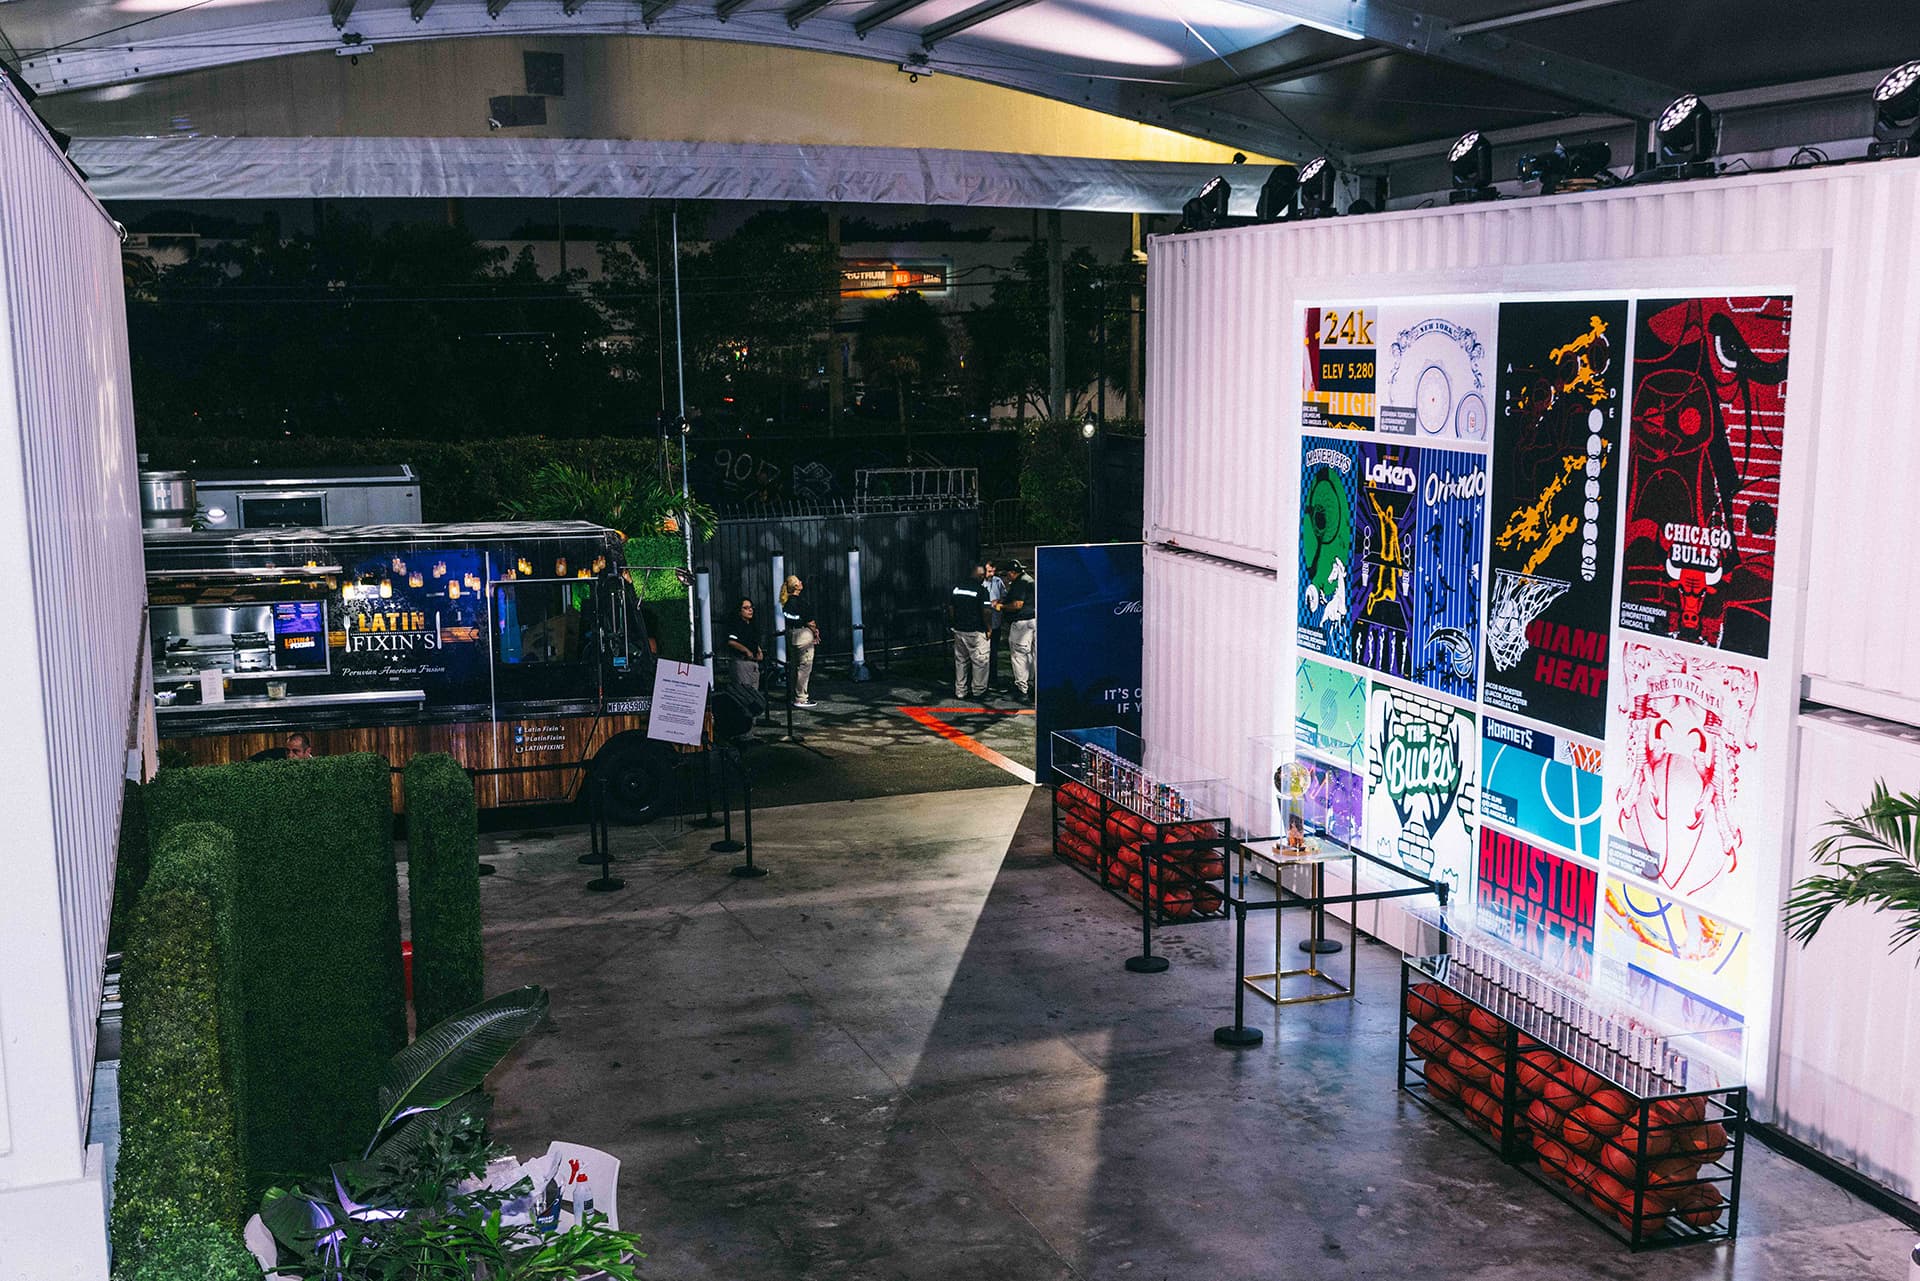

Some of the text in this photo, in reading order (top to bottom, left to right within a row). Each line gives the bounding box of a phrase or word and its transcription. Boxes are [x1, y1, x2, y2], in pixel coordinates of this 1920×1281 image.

[1323, 309, 1374, 345] 24k
[1322, 361, 1374, 381] ELEV 5,280
[1506, 363, 1513, 374] A
[1609, 388, 1616, 398] D
[1306, 448, 1351, 474] MAVERICKS
[1365, 457, 1416, 492] Lakers
[1664, 522, 1732, 549] CHICAGO
[1671, 543, 1720, 567] BULLS
[357, 611, 425, 632] LATIN
[352, 633, 435, 652] FIXIN'S
[1525, 619, 1608, 663] MIAMI
[342, 664, 446, 677] Peruvian American Fusion
[1534, 654, 1608, 698] HEAT
[1105, 687, 1129, 701] IT'S
[1649, 678, 1720, 709] TREE TO ATLANTA
[1118, 703, 1129, 714] IF
[1406, 723, 1428, 743] THE
[1486, 718, 1533, 750] HORNETS
[525, 744, 565, 752] LATINFIXINS
[1385, 736, 1457, 795] Bucks
[1479, 826, 1597, 927] HOUSTON
